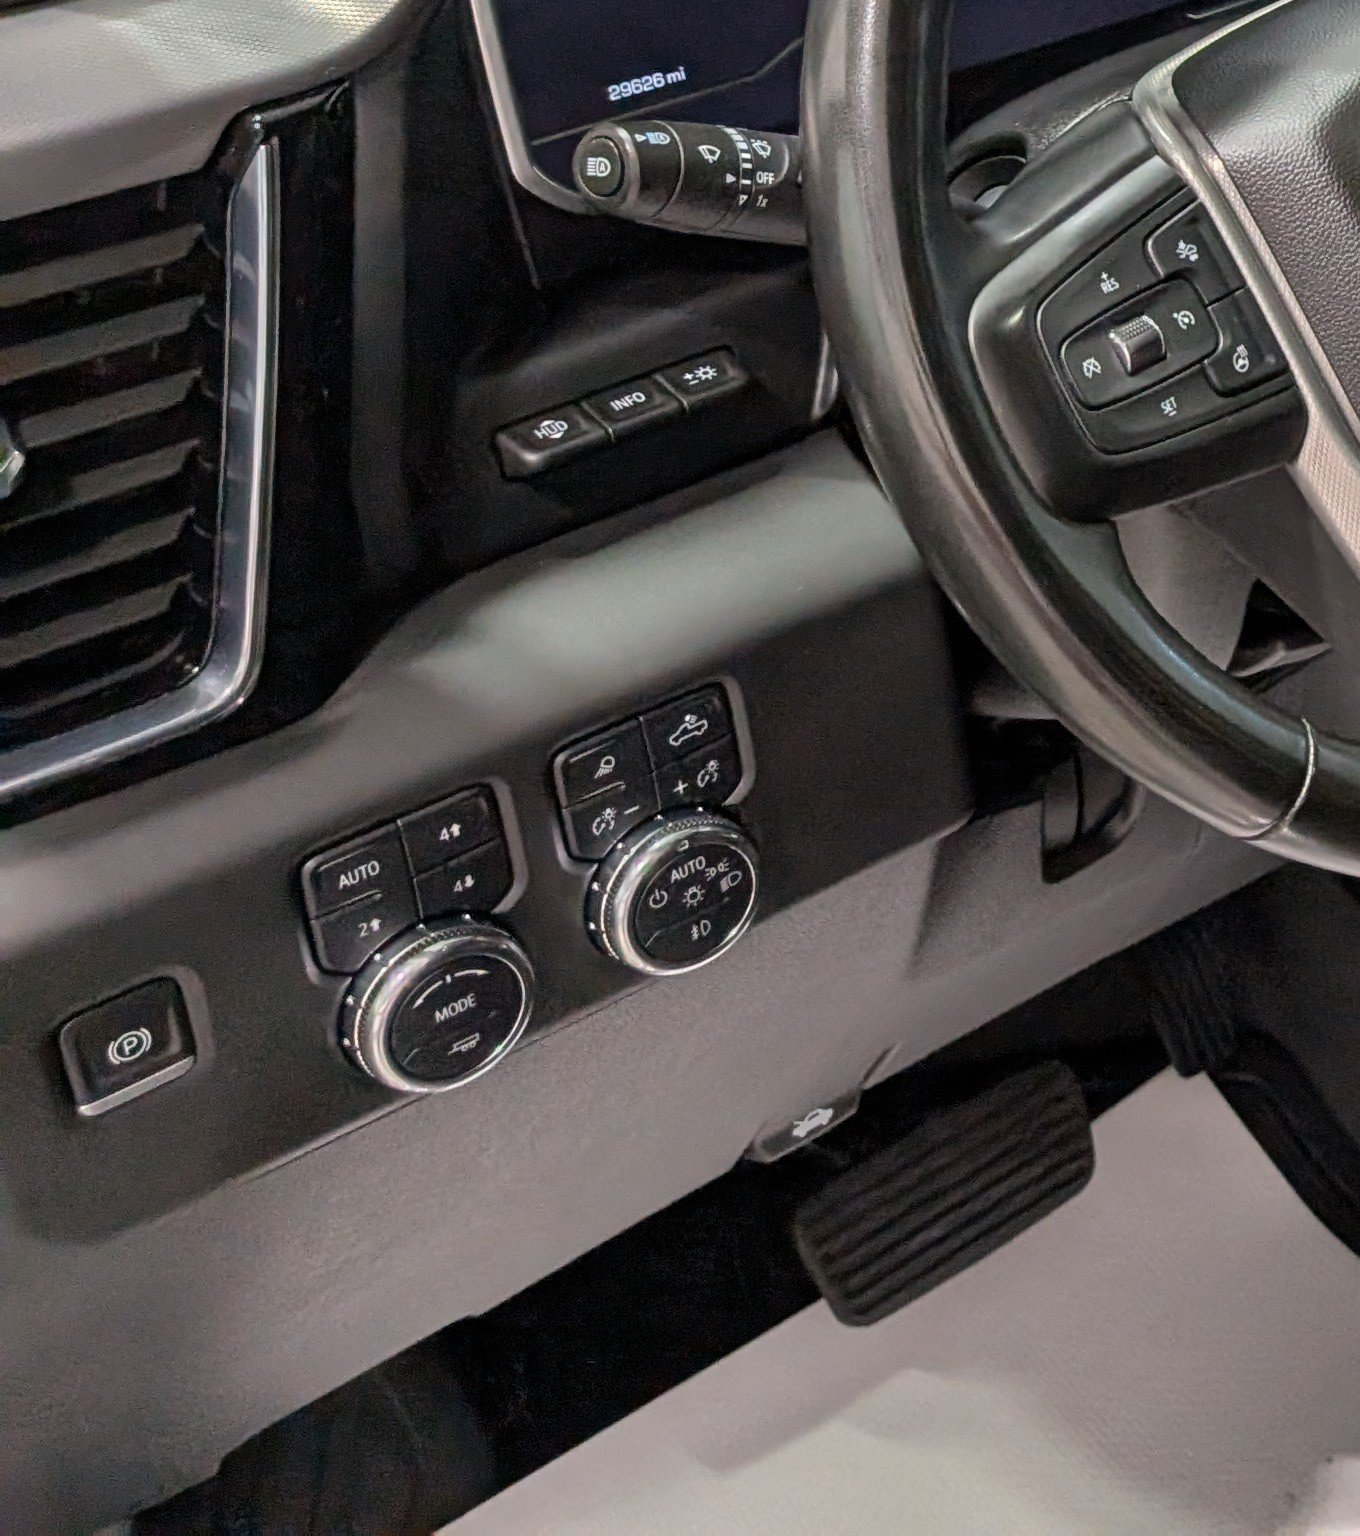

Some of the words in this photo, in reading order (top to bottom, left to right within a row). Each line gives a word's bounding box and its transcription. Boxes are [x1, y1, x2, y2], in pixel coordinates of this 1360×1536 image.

[607, 72, 666, 102] 29626
[667, 66, 687, 84] mi
[756, 172, 775, 186] OFF
[1100, 275, 1120, 294] RES
[609, 391, 647, 412] INFO
[1160, 396, 1177, 413] SET
[533, 419, 569, 440] HUD
[338, 860, 380, 891] AUTO
[670, 855, 706, 884] AUTO
[433, 993, 477, 1023] MODE
